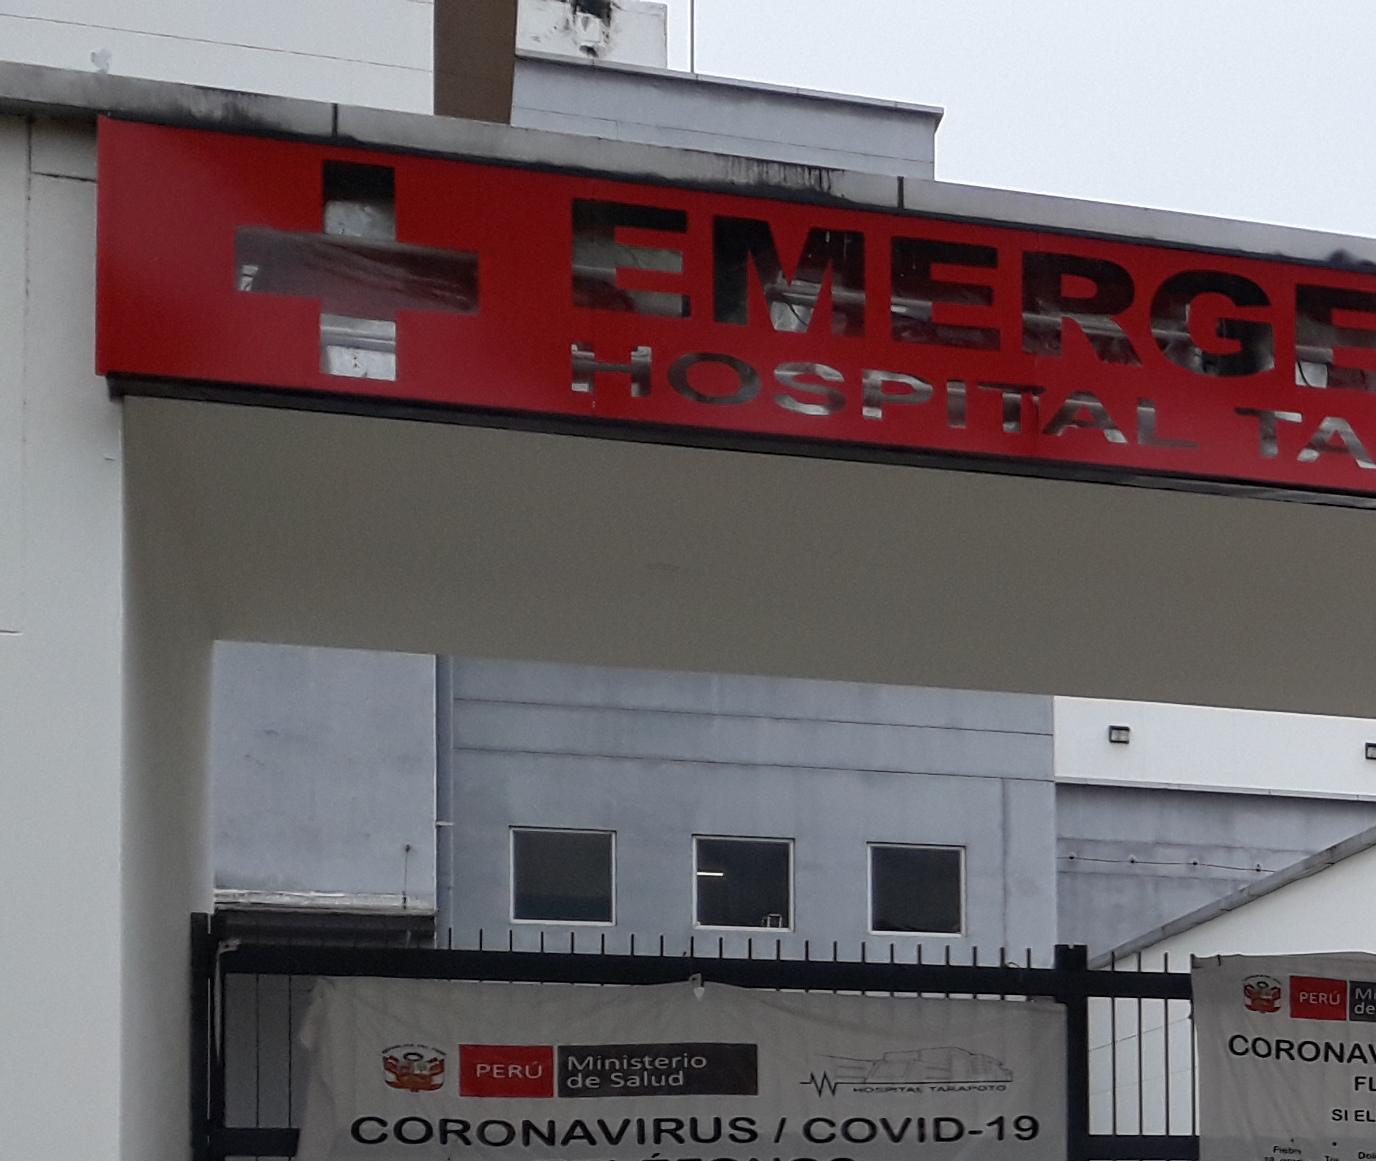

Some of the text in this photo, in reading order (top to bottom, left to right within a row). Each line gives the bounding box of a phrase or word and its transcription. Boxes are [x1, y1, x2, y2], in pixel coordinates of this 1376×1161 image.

[571, 343, 1197, 450] HOSPITAL
[1298, 990, 1341, 1006] PERÚ
[1354, 1002, 1376, 1015] de
[476, 1060, 543, 1078] PERÚ
[567, 1053, 707, 1070] Ministerio
[566, 1071, 684, 1089] de Salud
[1332, 1109, 1348, 1121] SI
[1355, 1110, 1376, 1122] EL
[351, 1116, 1039, 1147] CORONAVIRUS / COVID-19
